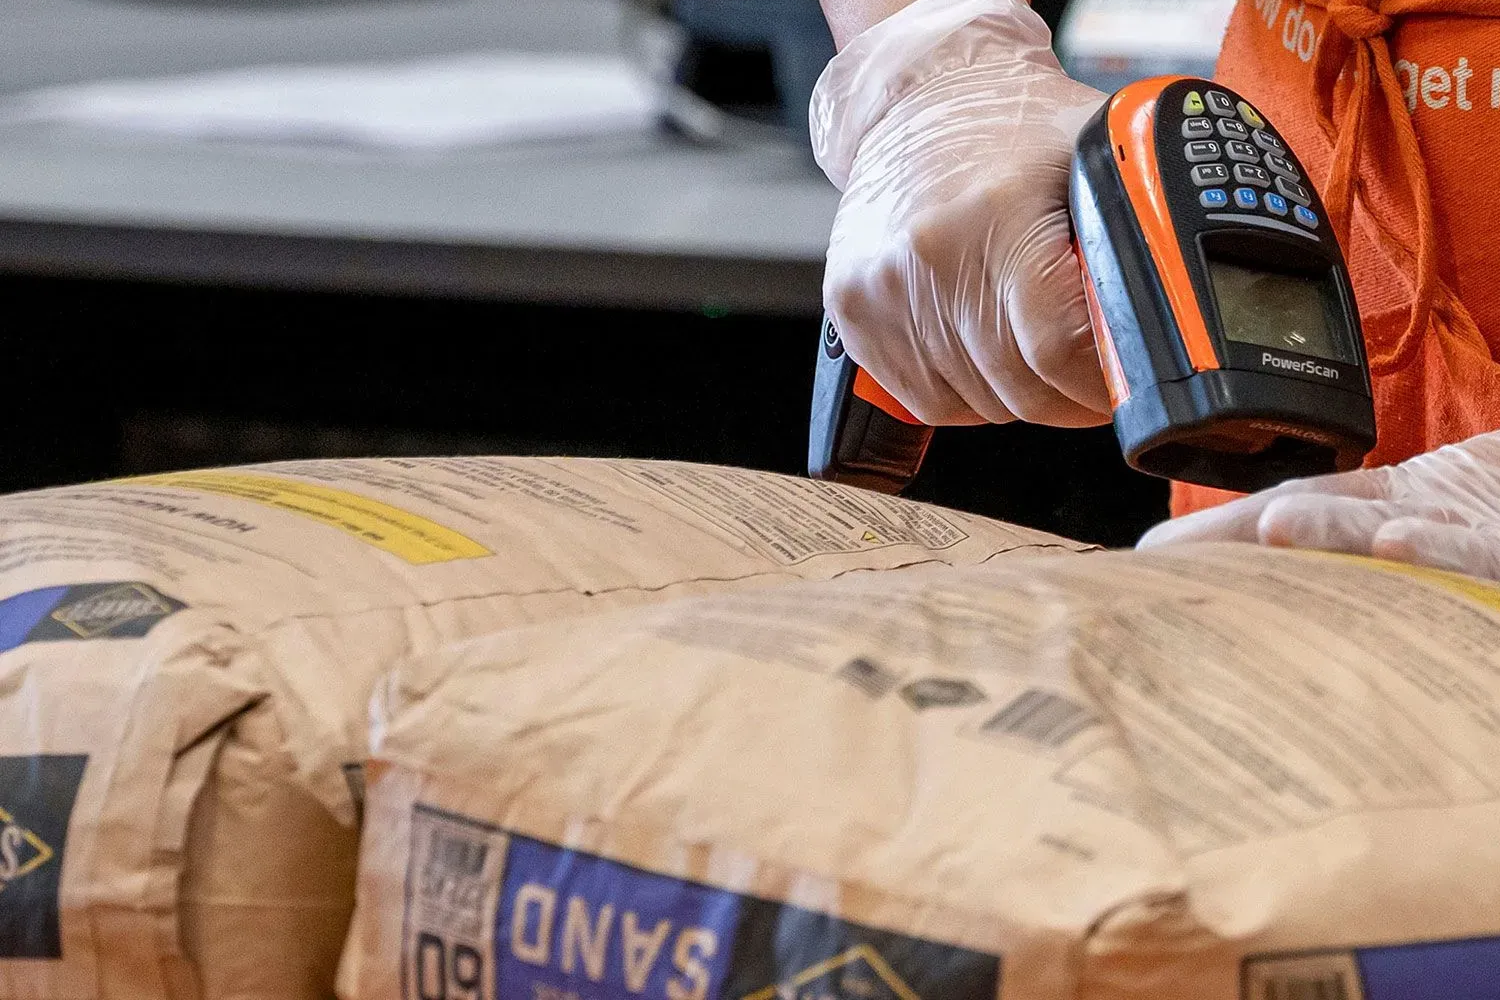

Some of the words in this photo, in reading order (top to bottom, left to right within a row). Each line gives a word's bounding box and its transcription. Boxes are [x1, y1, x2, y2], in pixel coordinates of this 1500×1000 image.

[1221, 97, 1229, 107] 0
[1201, 119, 1210, 129] 9
[1235, 122, 1244, 132] 8
[1208, 143, 1217, 152] 6
[1245, 145, 1253, 155] 5
[1215, 166, 1224, 177] 3
[1255, 168, 1264, 179] 2
[1262, 352, 1339, 380] PowerScan
[511, 883, 718, 1000] SAND
